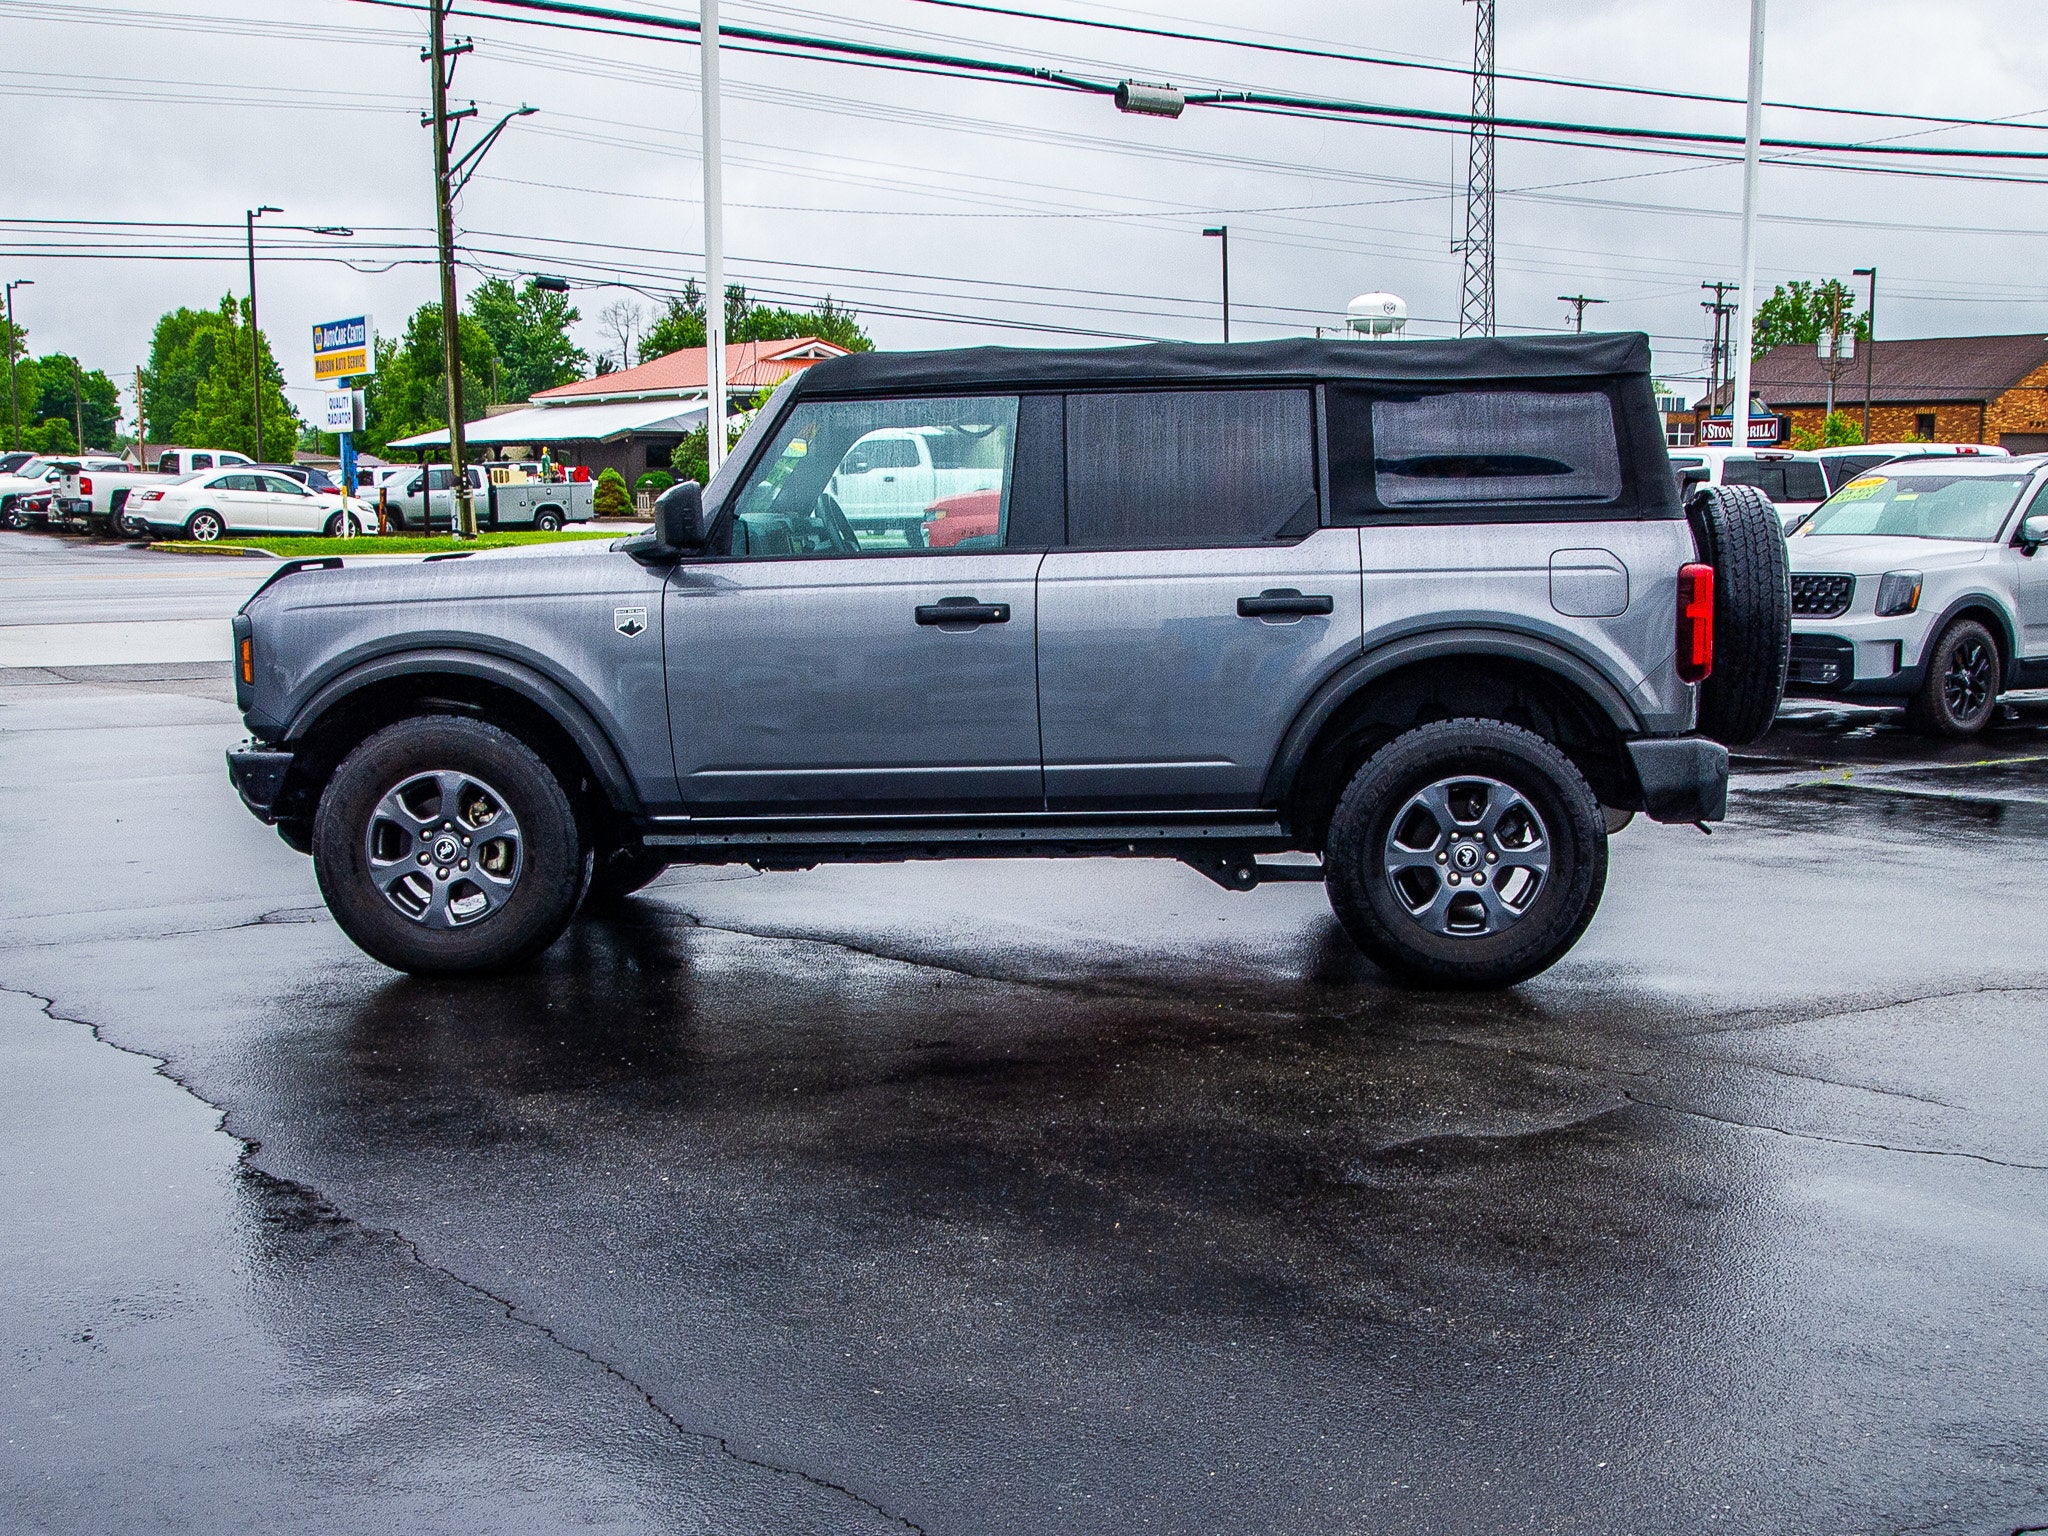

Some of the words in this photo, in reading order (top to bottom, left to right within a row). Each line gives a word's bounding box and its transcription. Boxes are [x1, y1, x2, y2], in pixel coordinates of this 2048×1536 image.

[336, 357, 346, 370] AUTO
[347, 355, 365, 368] SERVICE
[329, 396, 349, 409] QUALITY
[328, 412, 350, 424] RADIATOR
[1707, 423, 1733, 439] STON
[1748, 423, 1770, 438] RILL
